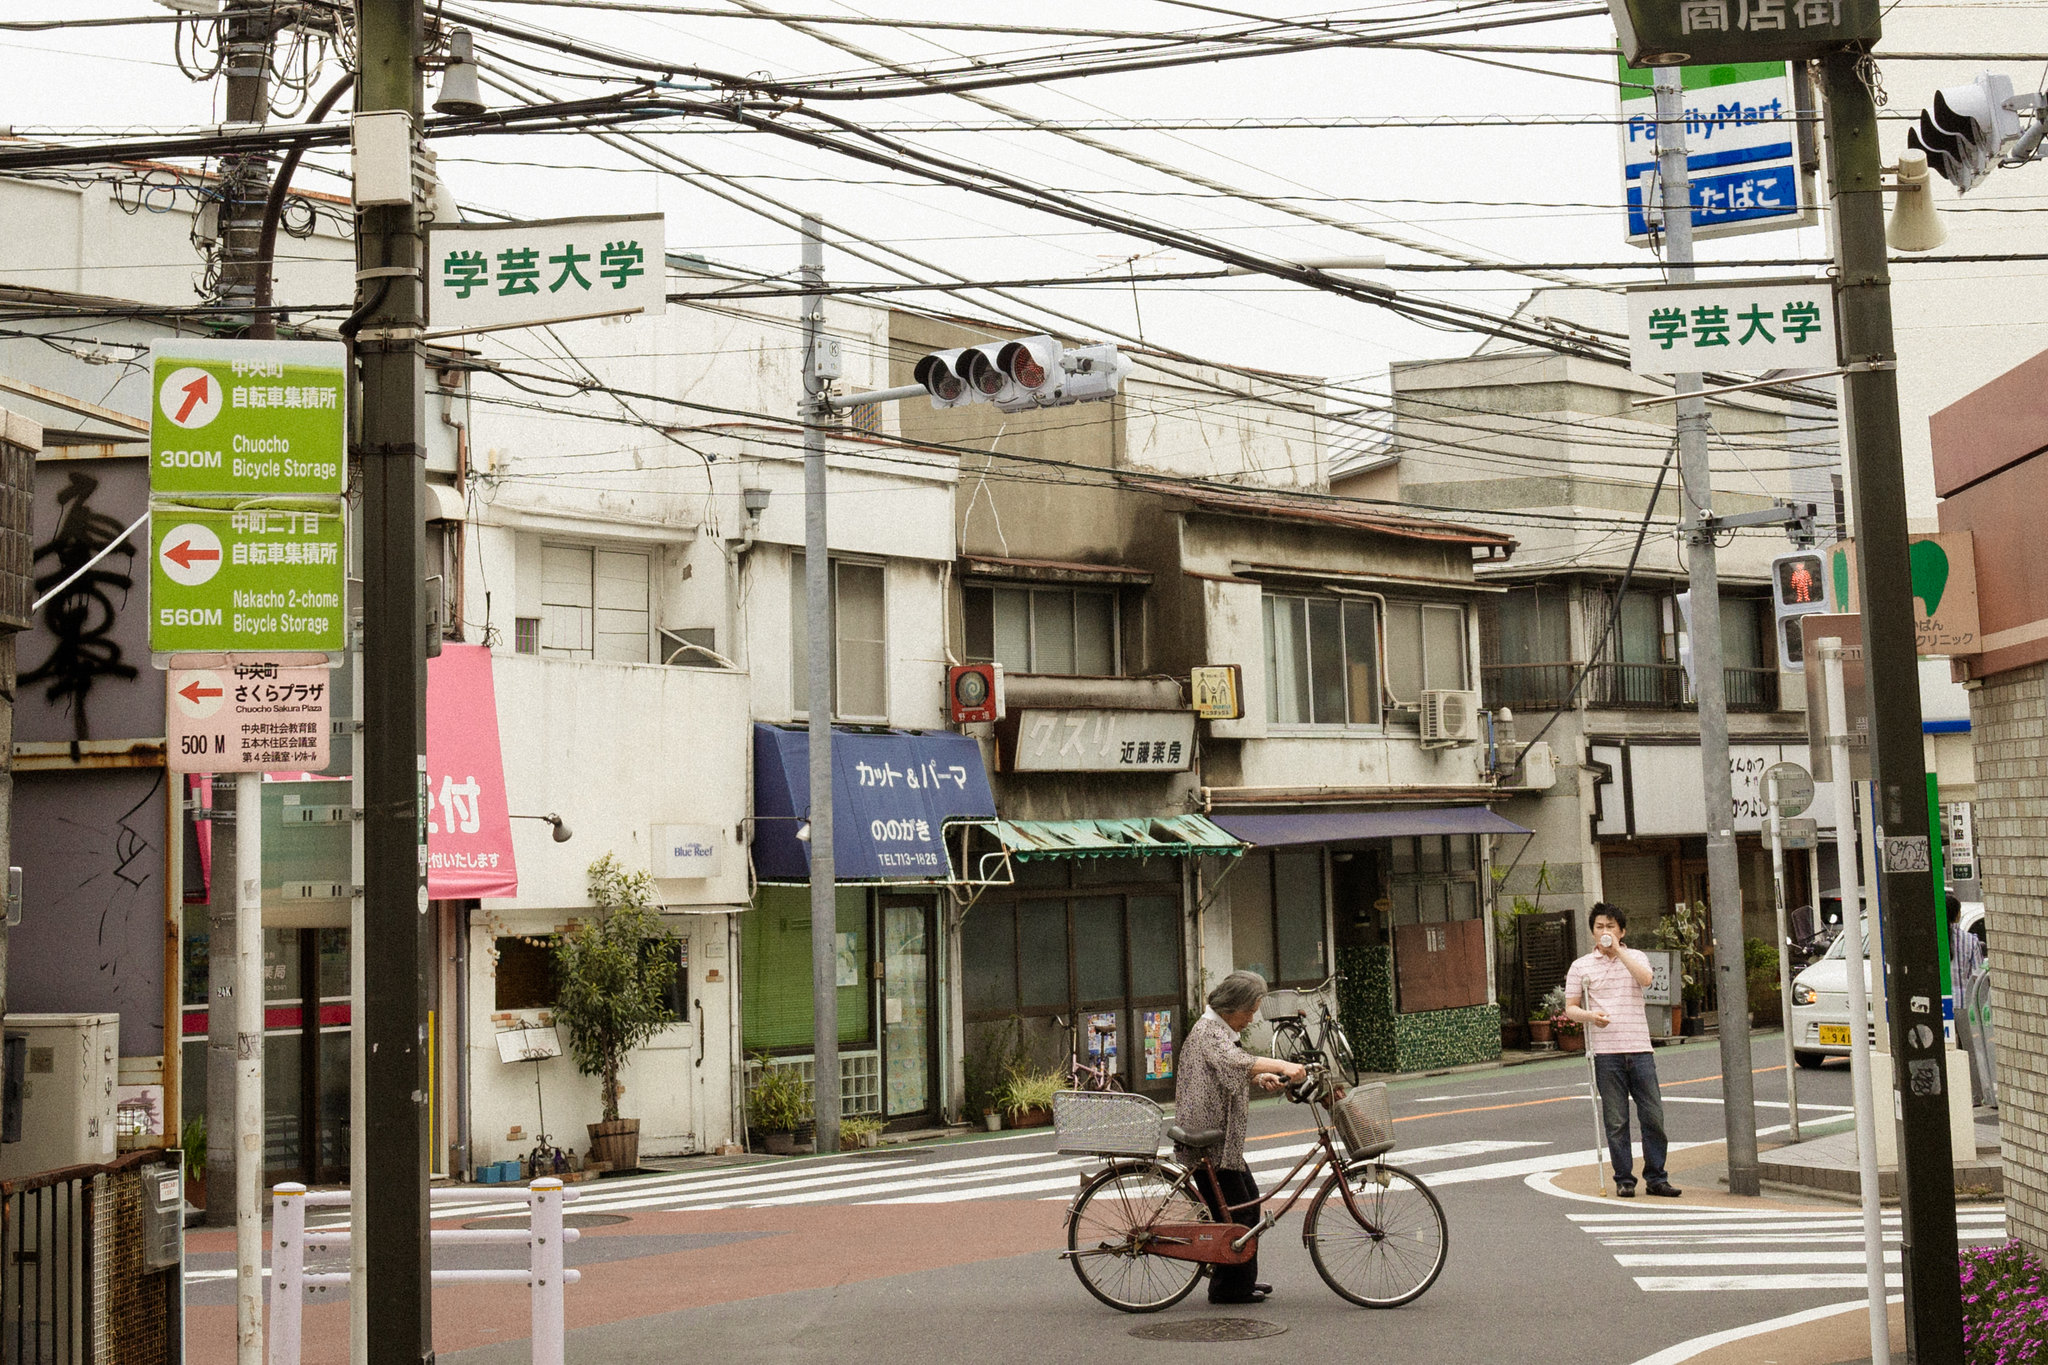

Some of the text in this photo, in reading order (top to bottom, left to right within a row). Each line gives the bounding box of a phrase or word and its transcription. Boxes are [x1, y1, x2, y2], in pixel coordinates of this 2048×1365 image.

[1680, 0, 1841, 35] 商店街
[1629, 97, 1783, 142] FailyMart
[1700, 178, 1781, 217] たばこ
[444, 240, 645, 299] 学芸大学
[1648, 301, 1822, 350] 学芸大学
[232, 386, 337, 409] 自転車集積所
[232, 434, 289, 453] Chuocho
[160, 450, 222, 468] 300M
[232, 459, 337, 479] Bicycle Storage
[231, 511, 319, 534] 中町二丁目
[232, 542, 338, 565] 自転車集積所
[233, 589, 339, 608] Nakacho 2-chome
[160, 608, 222, 626] 560M
[233, 614, 329, 635] Bicycle Storage
[1914, 619, 1944, 632] ぱん
[1916, 633, 1974, 648] クリニック
[234, 662, 280, 680] 中央町
[235, 684, 324, 702] さくらプラザ
[236, 704, 322, 713] Chuocho Sakura Plaza
[241, 723, 317, 734] 中央町社会教育館
[1029, 715, 1117, 757] クスリ
[181, 734, 225, 754] 500 M
[1119, 741, 1183, 764] 近藤薬房
[427, 775, 481, 834] 付
[871, 819, 932, 842] ののがき
[674, 846, 714, 857] Blue Reef
